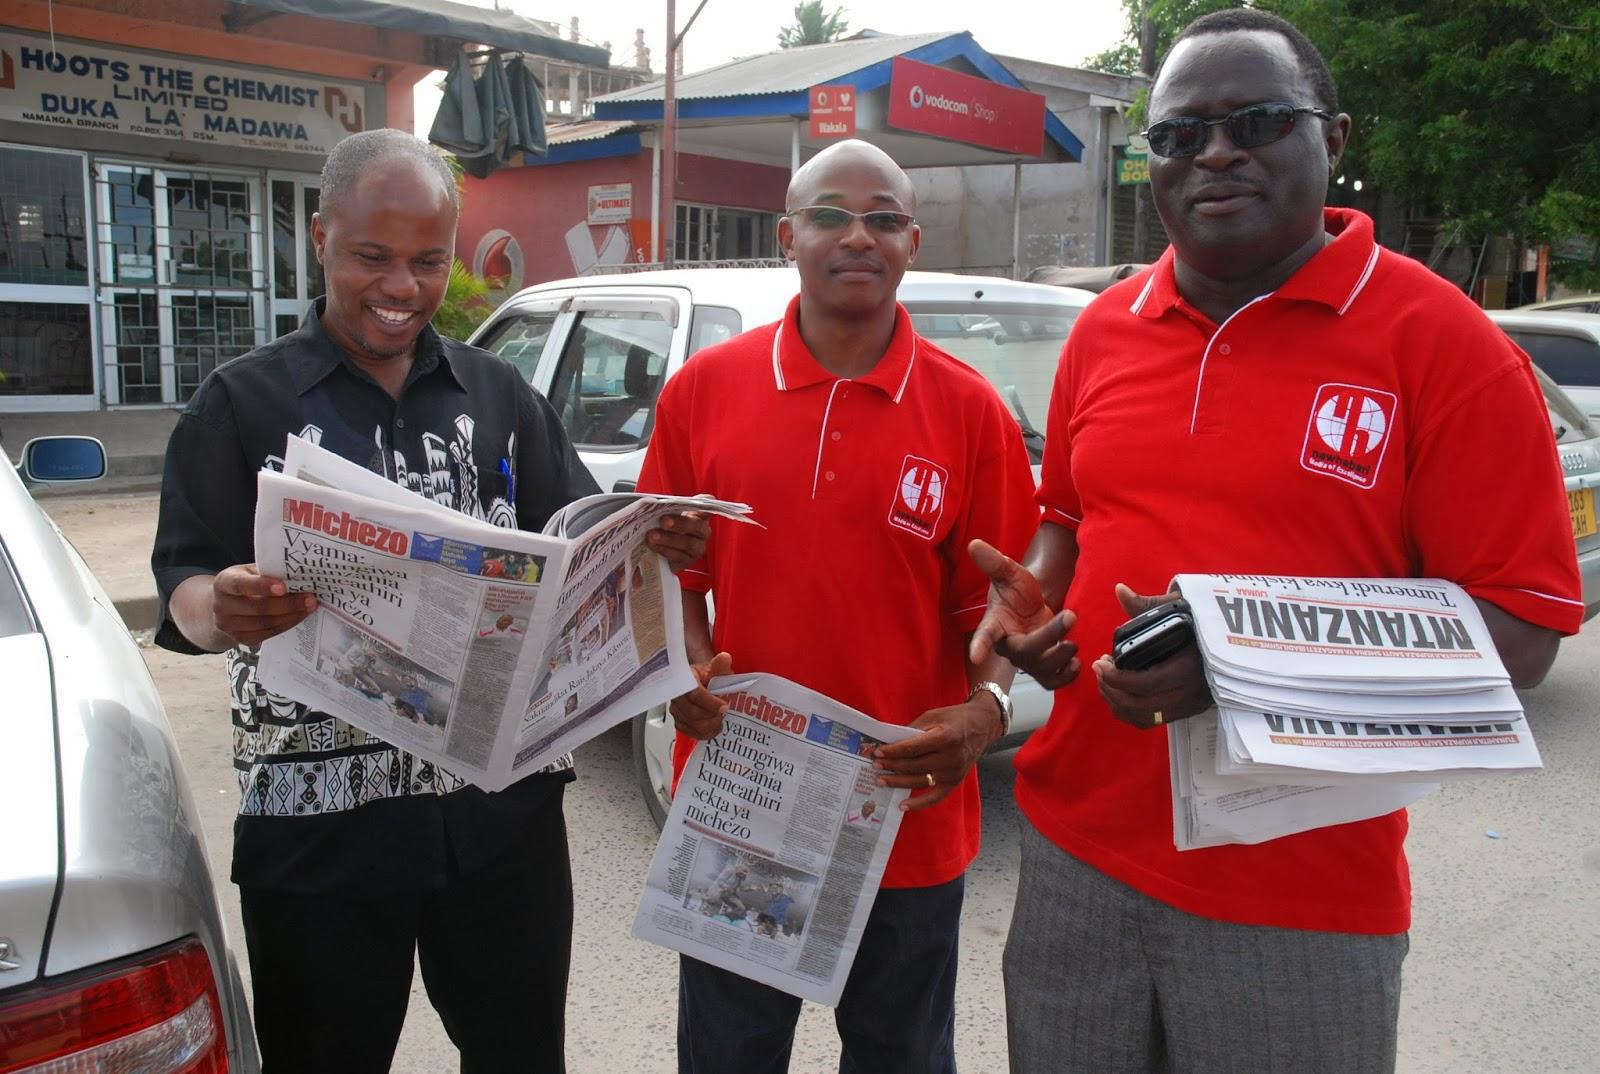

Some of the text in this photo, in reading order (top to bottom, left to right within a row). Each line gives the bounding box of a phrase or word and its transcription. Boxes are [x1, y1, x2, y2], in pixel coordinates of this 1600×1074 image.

[21, 47, 319, 108] HOOTS THE CHEMIST
[113, 84, 228, 112] LIMITED
[925, 94, 968, 114] vodacom
[22, 112, 73, 125] NAMANGA
[77, 118, 119, 130] BRANCH
[41, 93, 309, 141] DUKA LA MADAWA
[288, 499, 408, 556] Michezo
[1303, 578, 1349, 595] kwa
[1351, 582, 1456, 608] Tumerudi
[1215, 595, 1476, 650] MTANZANIA
[721, 719, 771, 746] yama:
[702, 746, 783, 794] Mtanzania
[707, 737, 795, 776] Kufungiwa
[691, 786, 750, 821] sekta ya
[697, 763, 783, 812] kumeathiri
[685, 804, 751, 840] michezo
